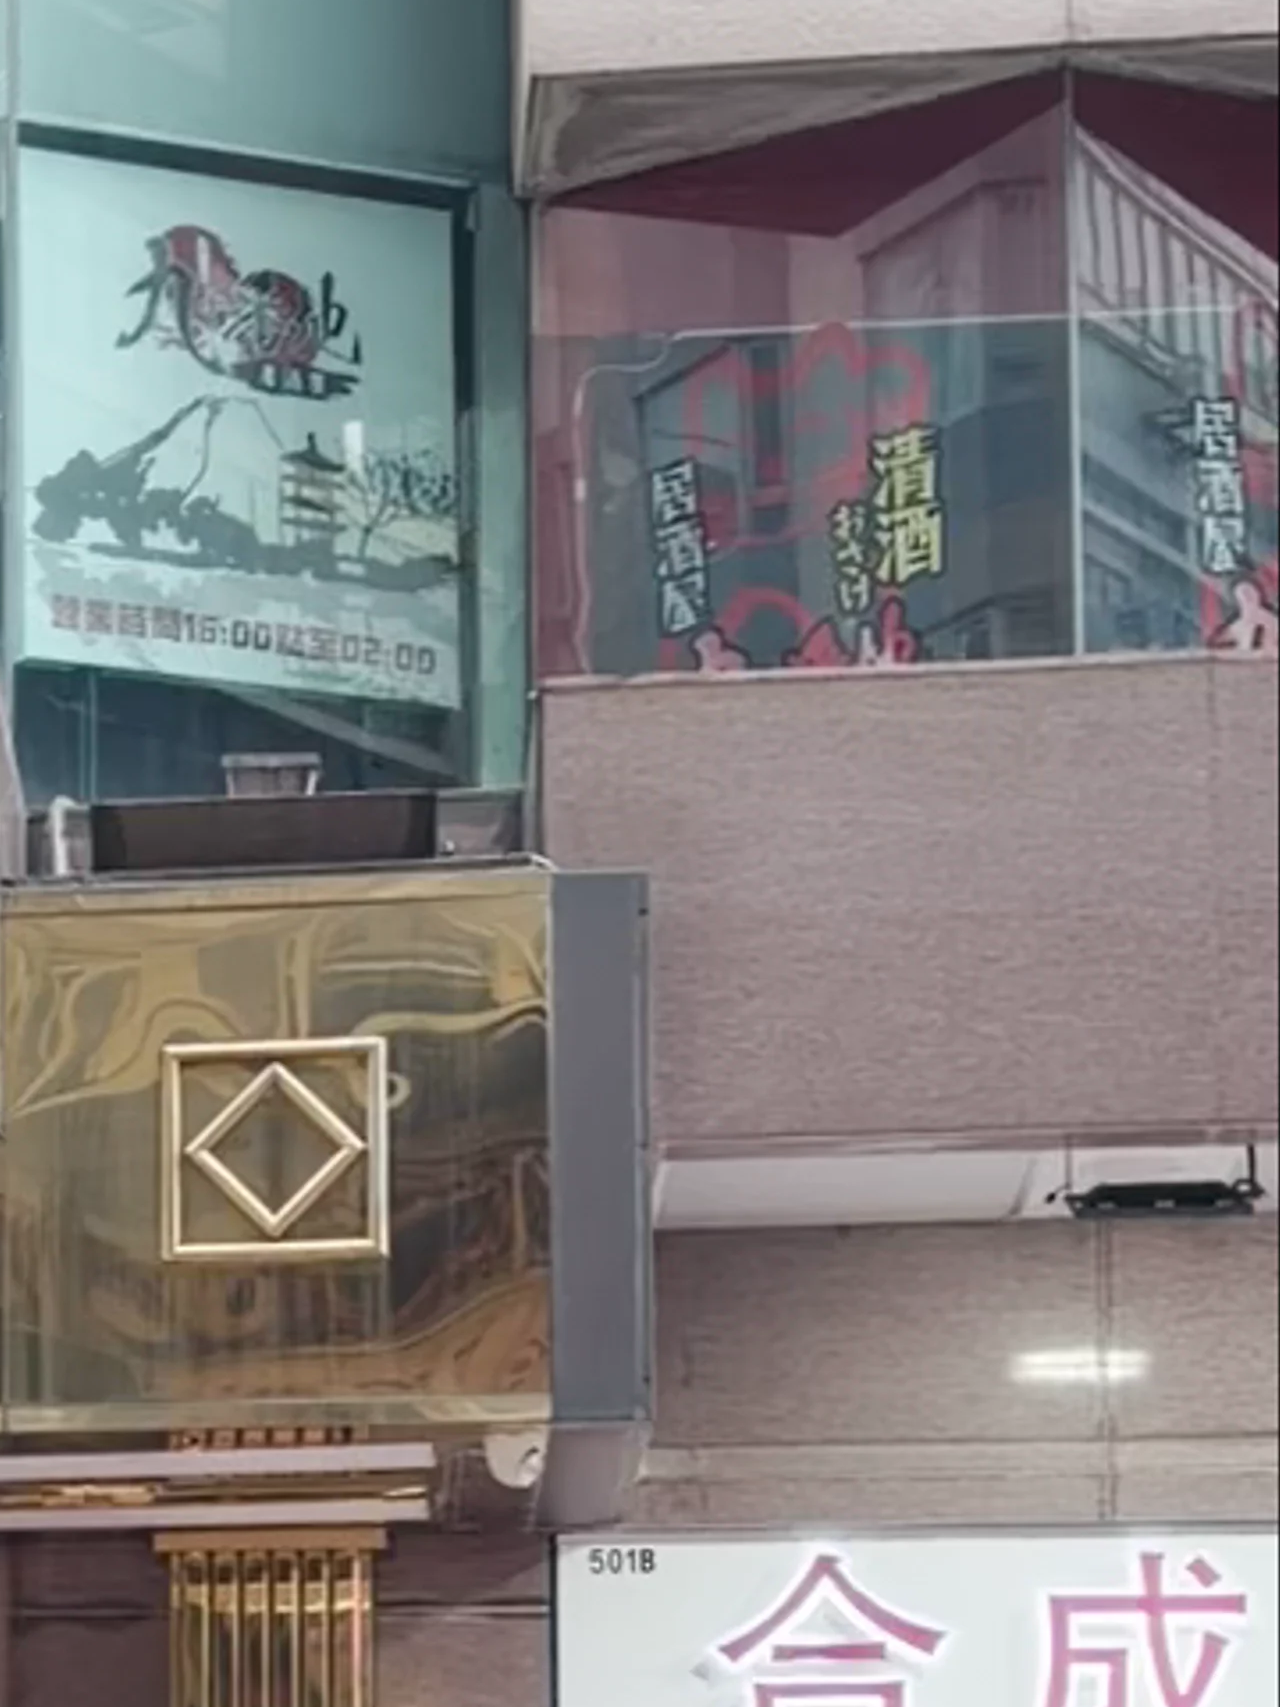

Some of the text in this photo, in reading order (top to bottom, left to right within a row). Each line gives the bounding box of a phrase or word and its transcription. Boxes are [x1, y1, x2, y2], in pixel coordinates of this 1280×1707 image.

[652, 460, 707, 633] 居酒屋
[872, 426, 944, 585] 清酒
[1195, 398, 1245, 572] 居酒屋
